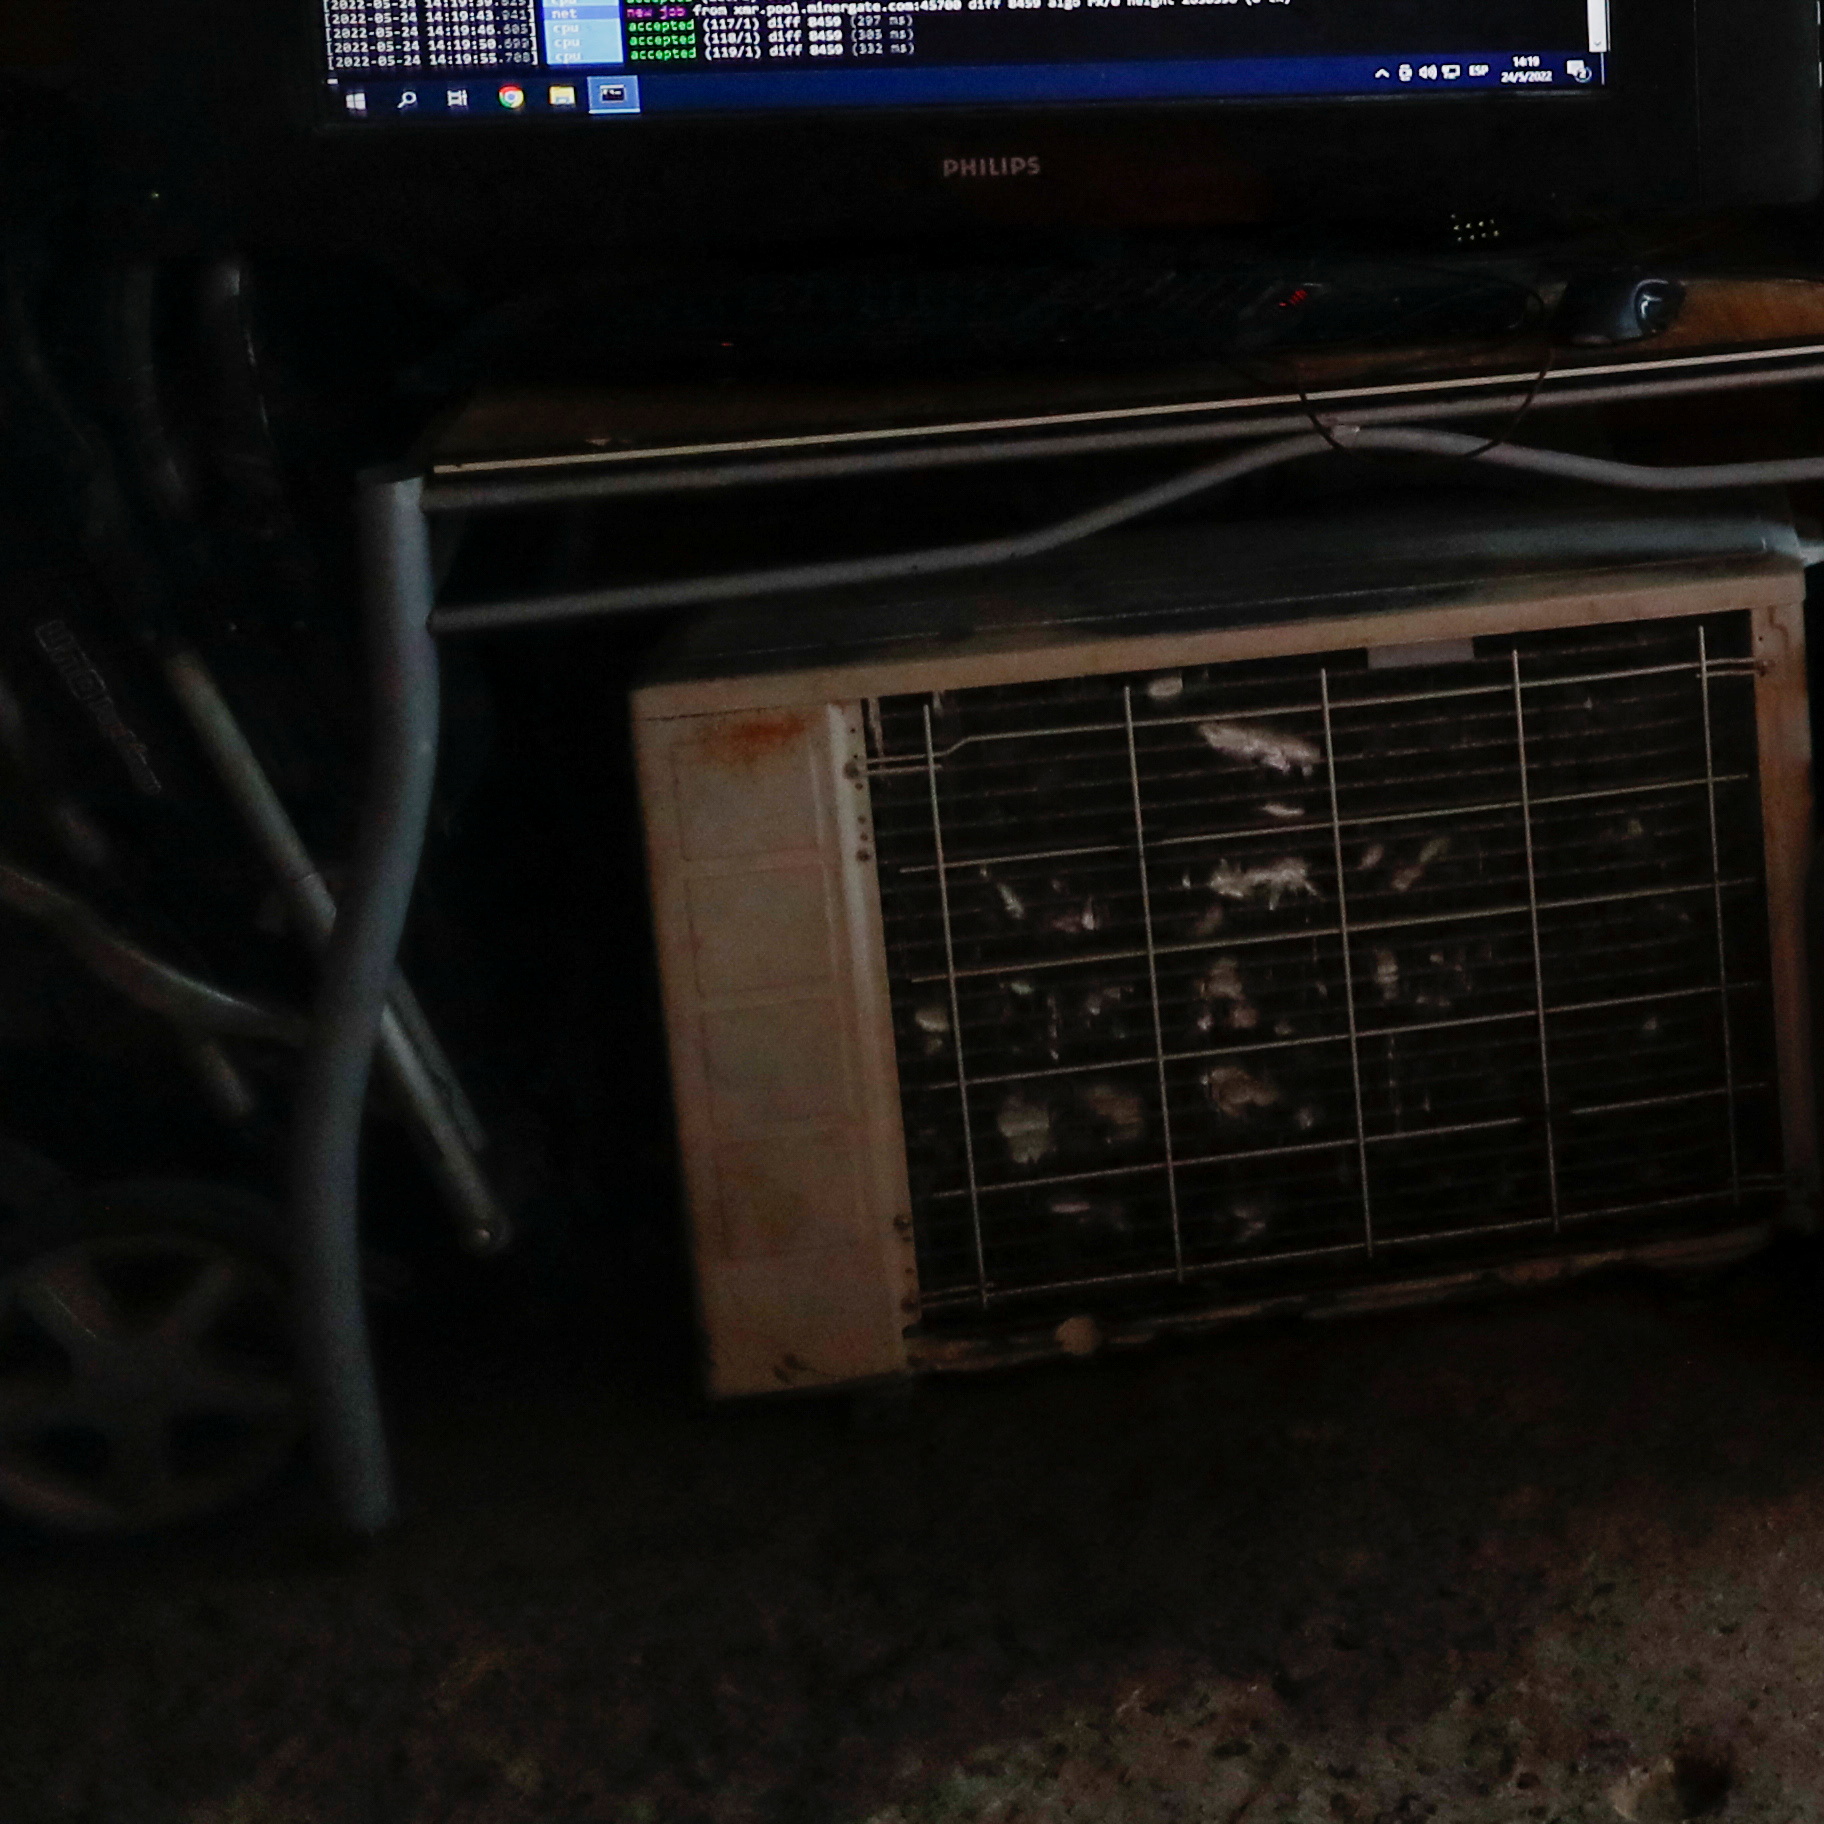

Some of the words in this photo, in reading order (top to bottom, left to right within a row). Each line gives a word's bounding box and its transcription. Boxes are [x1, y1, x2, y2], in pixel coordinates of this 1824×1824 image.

[325, 10, 417, 27] [2022-05-24
[552, 8, 577, 18] net
[627, 8, 652, 17] new
[660, 5, 685, 19] job
[693, 4, 726, 16] from
[326, 26, 418, 41] [2022-05-24
[553, 24, 579, 35] cpu
[629, 18, 694, 32] accepted
[768, 16, 800, 29] diff
[890, 14, 912, 26] ms)
[327, 40, 419, 55] [2022-05-24
[554, 38, 580, 49] cpu
[630, 33, 695, 46] accepted
[768, 30, 801, 43] diff
[890, 29, 913, 40] ms)
[328, 55, 420, 70] [2022-05-24
[555, 52, 581, 63] cpu
[631, 47, 696, 60] accepted
[770, 44, 802, 56] diff
[891, 42, 914, 54] ms)
[943, 155, 1041, 177] PHILIPS
